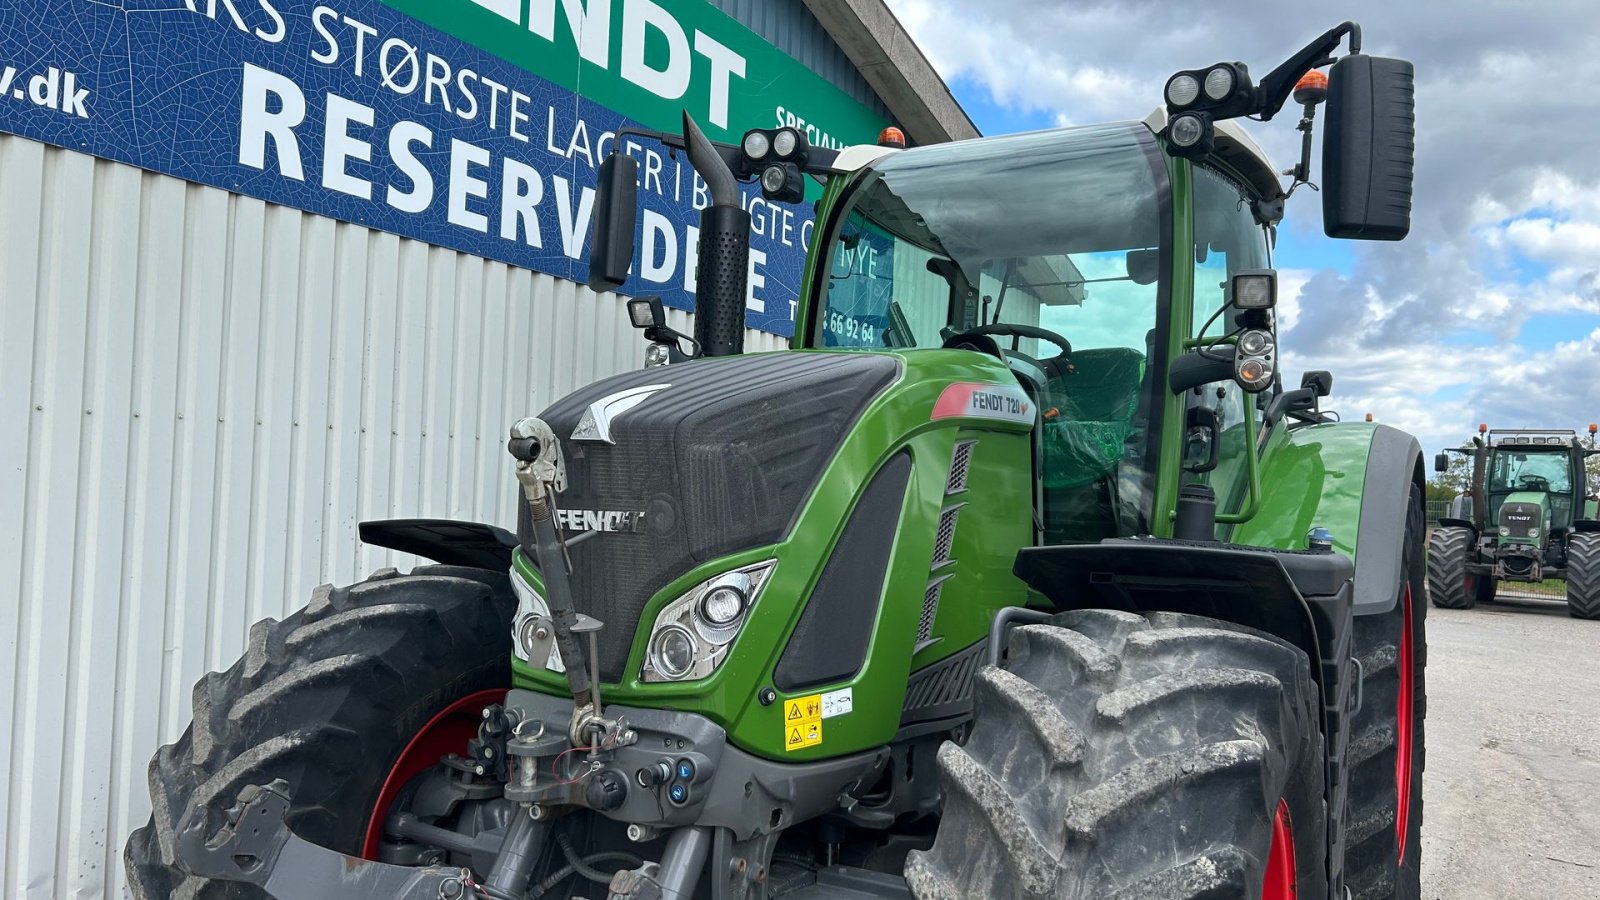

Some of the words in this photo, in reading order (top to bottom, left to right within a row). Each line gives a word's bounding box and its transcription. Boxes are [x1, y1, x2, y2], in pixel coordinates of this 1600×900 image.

[470, 0, 746, 130] NDT
[311, 5, 531, 143] STØRSTE
[674, 162, 681, 203] I
[692, 169, 794, 247] BGTE
[830, 312, 844, 335] 66
[846, 317, 859, 340] 92
[861, 322, 874, 344] 64
[972, 390, 1003, 412] FENDT
[1006, 397, 1020, 414] 720
